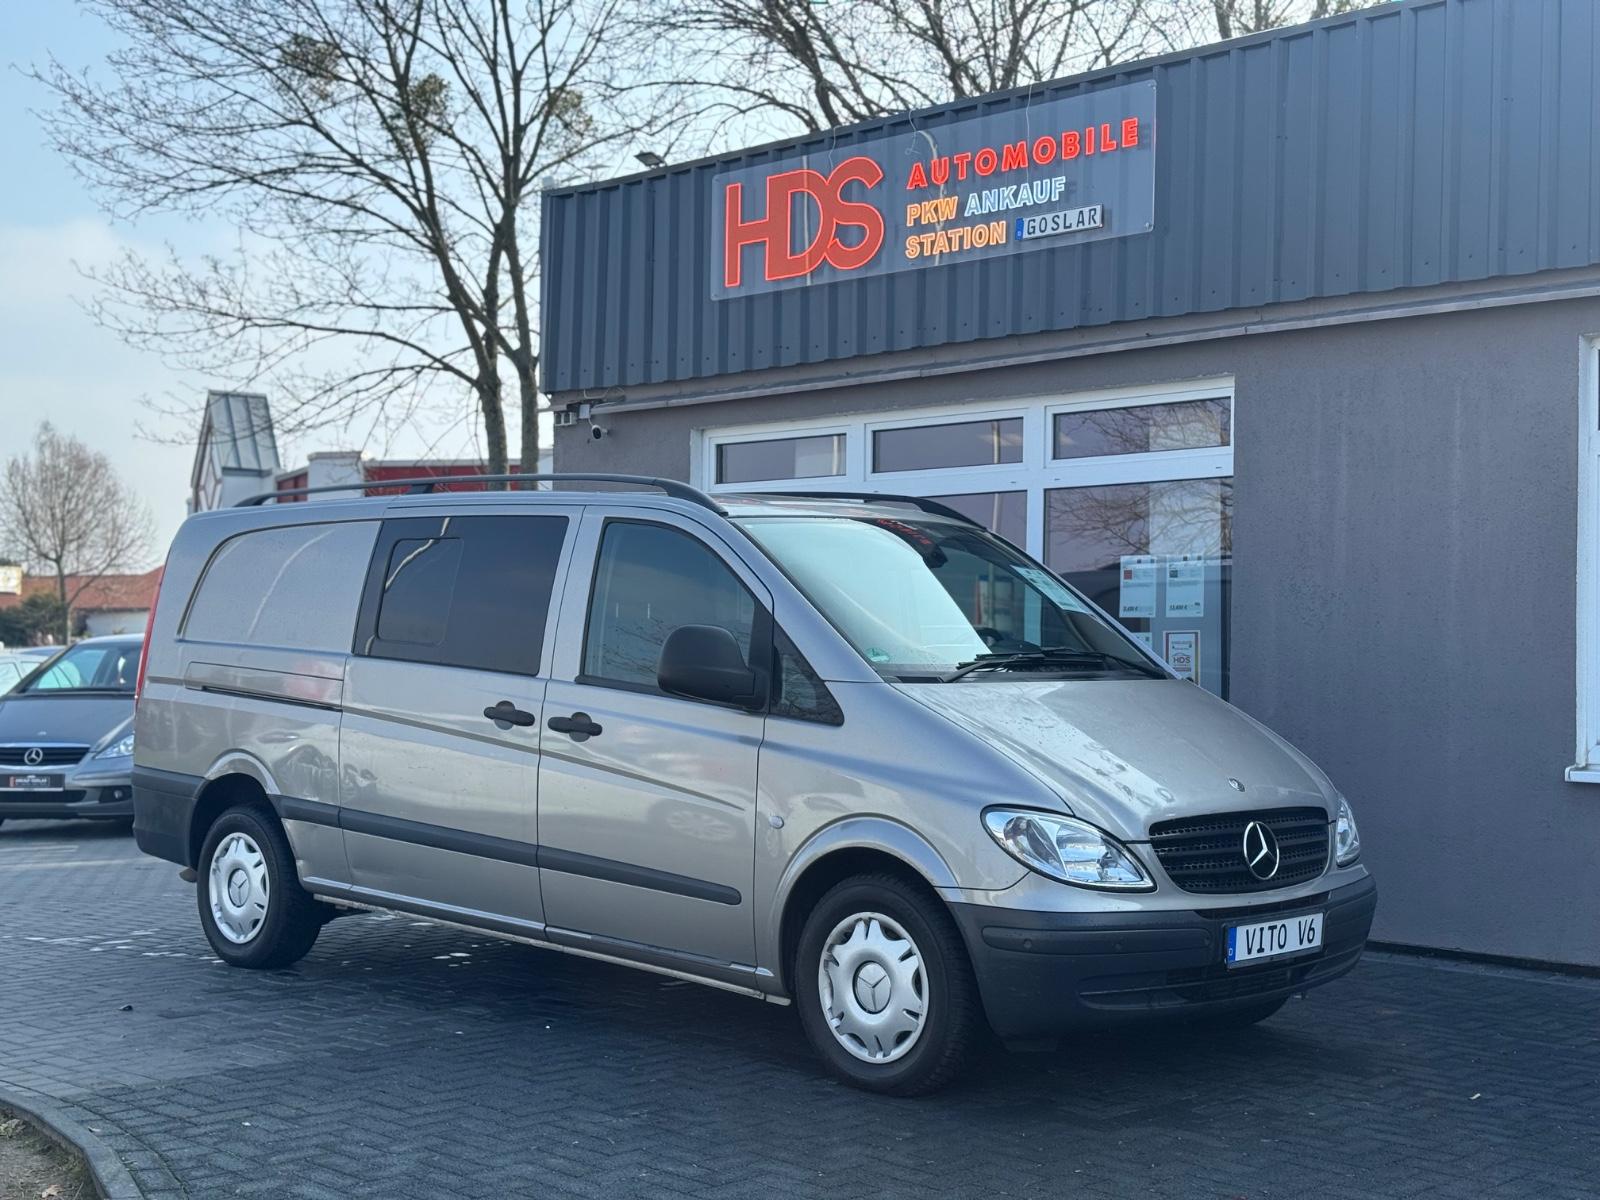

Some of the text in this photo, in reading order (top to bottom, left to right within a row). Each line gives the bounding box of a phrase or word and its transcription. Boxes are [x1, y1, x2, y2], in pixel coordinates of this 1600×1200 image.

[906, 117, 1139, 190] AUTOMOBILE
[906, 176, 1066, 227] PKW ANKAUF
[723, 156, 885, 288] HDS
[905, 220, 1007, 259] STATION
[1027, 208, 1097, 235] GOSLAR
[1173, 656, 1191, 664] HDS
[1245, 918, 1316, 955] VITO V6
